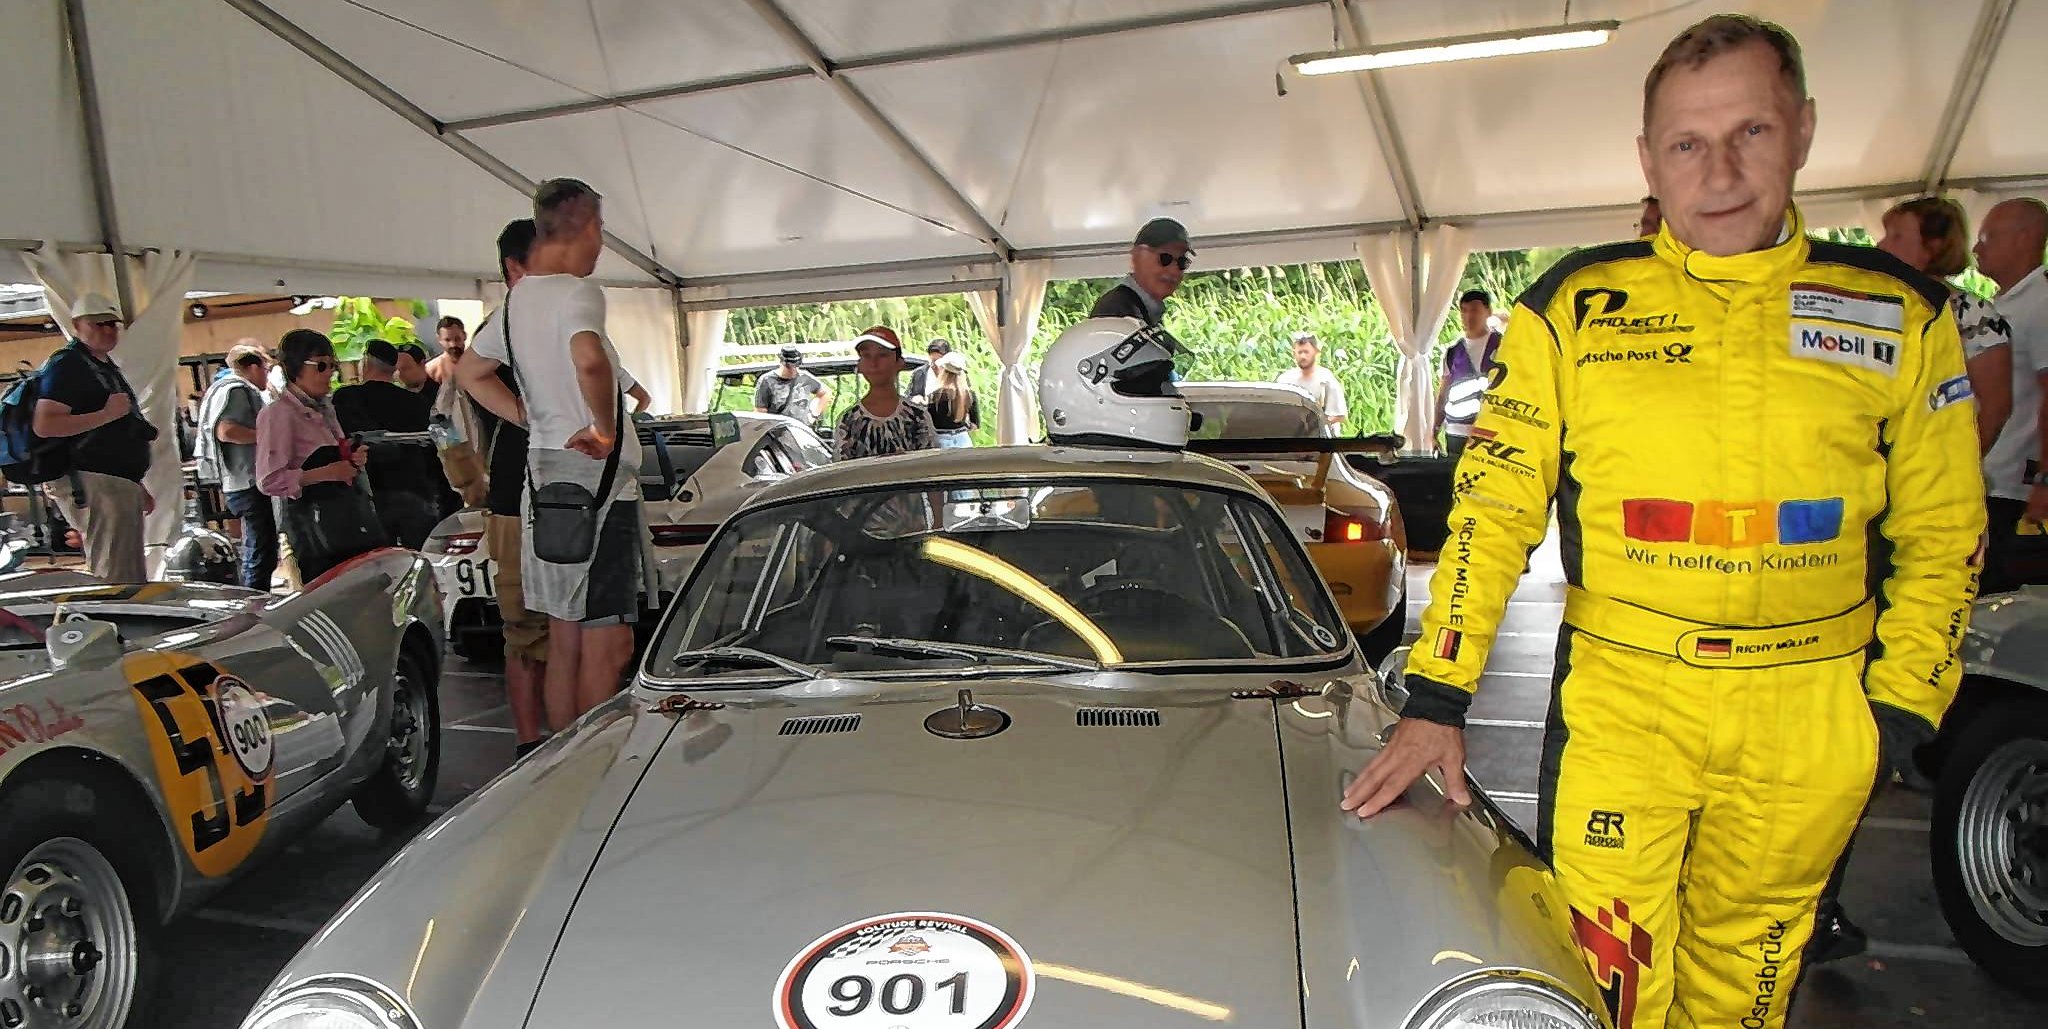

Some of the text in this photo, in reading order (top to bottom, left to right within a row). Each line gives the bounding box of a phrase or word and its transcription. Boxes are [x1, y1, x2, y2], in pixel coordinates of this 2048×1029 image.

[1626, 350, 1659, 362] Post
[1801, 328, 1865, 356] Mobil
[1458, 516, 1477, 564] RICHY
[1625, 545, 1658, 566] Wir
[1761, 552, 1839, 570] Kindern
[1736, 643, 1773, 654] RICHY
[234, 713, 267, 756] 900
[856, 919, 968, 936] SOLITUDE REVIVAL
[1738, 919, 1788, 1029] Osnabrück
[827, 972, 970, 1017] 901
